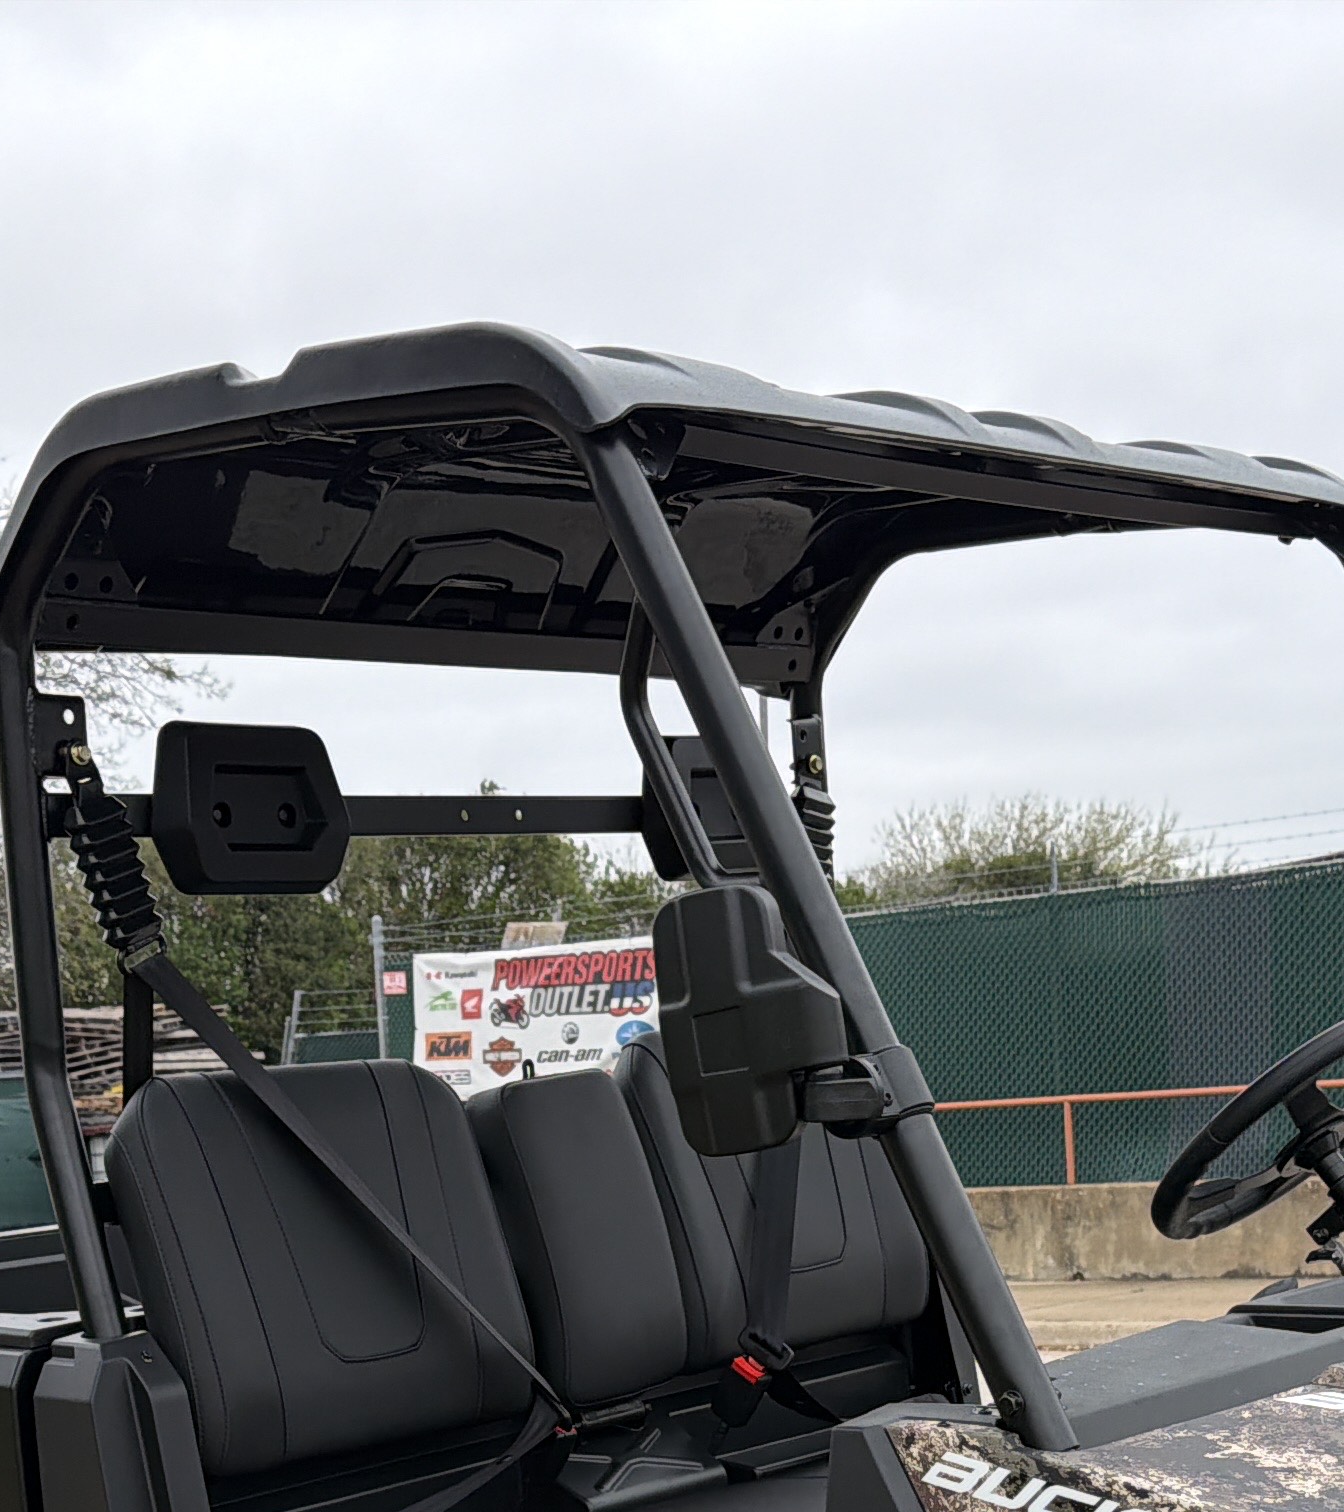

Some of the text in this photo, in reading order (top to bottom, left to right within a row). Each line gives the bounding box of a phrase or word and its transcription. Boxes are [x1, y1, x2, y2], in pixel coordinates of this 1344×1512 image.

[530, 980, 654, 1017] OUTLET.US
[428, 1034, 470, 1057] KTM
[536, 1048, 603, 1064] can-am
